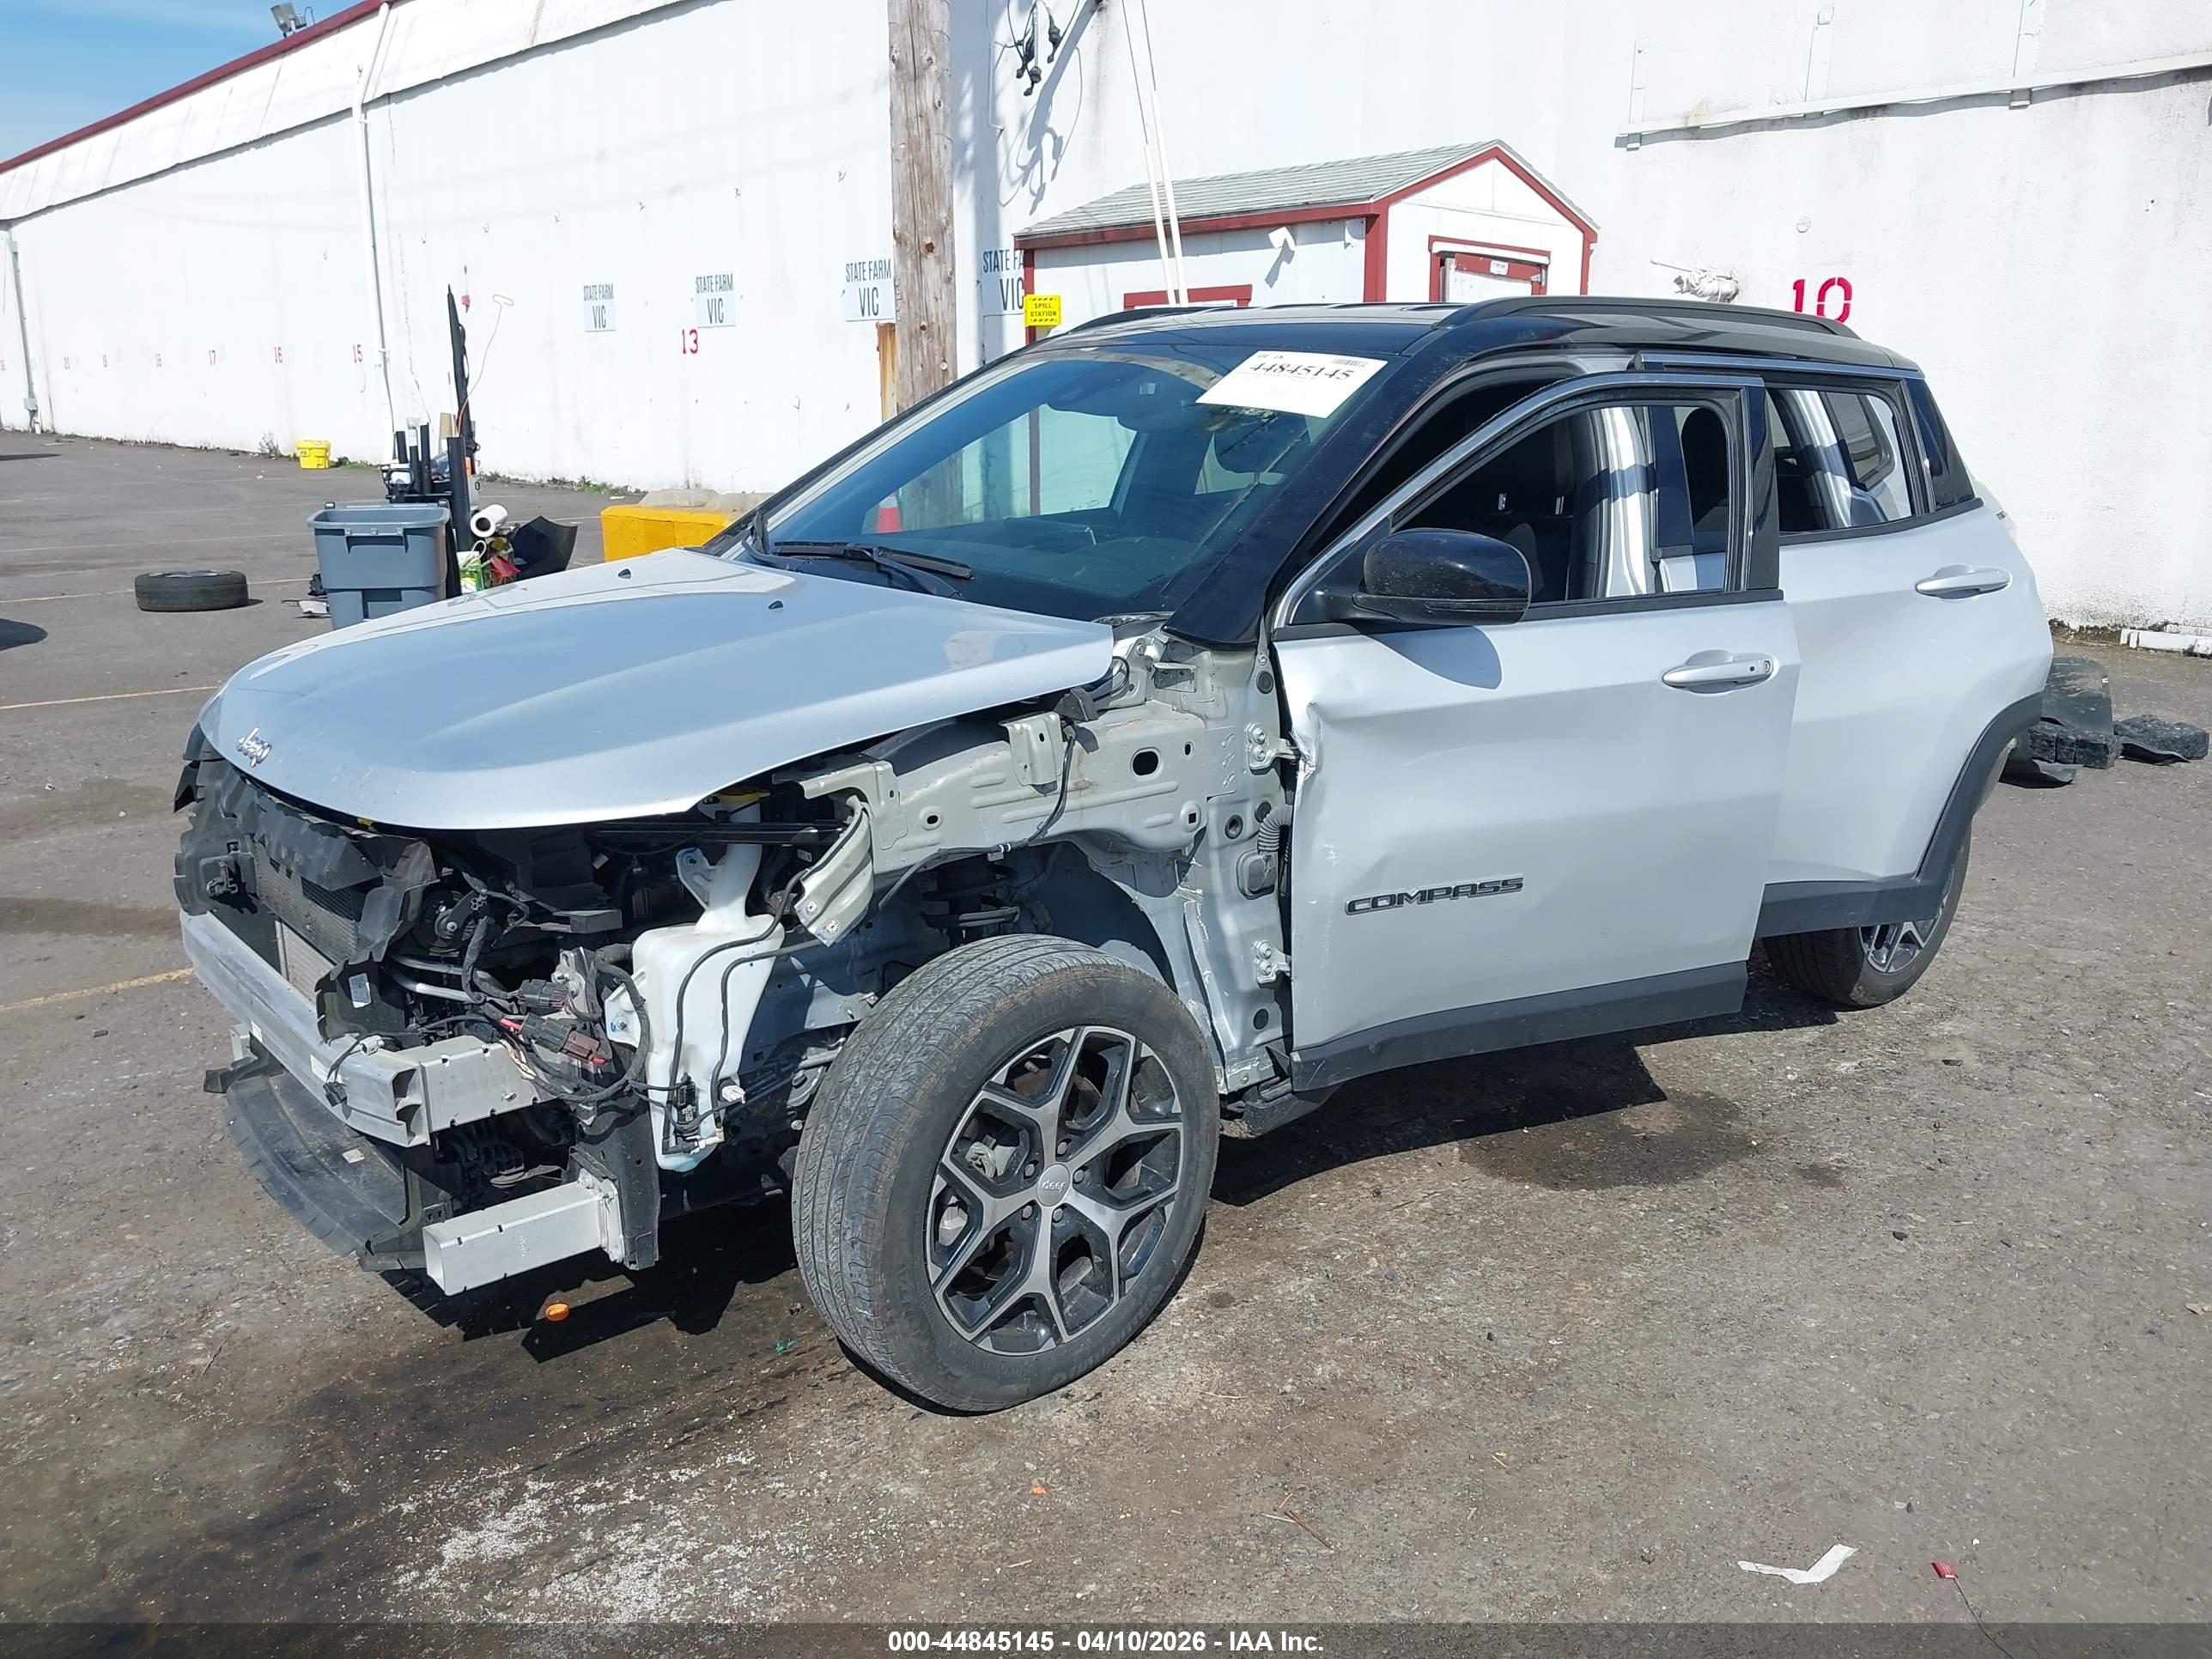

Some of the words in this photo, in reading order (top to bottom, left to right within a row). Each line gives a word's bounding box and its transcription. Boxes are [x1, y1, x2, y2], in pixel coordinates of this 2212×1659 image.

[845, 261, 867, 283] STATE
[868, 259, 891, 281] FARM
[982, 250, 1011, 273] STATE
[1013, 248, 1024, 270] FA
[583, 285, 598, 301] STATE
[599, 283, 614, 300] FARM
[695, 276, 714, 294] STATE
[715, 273, 733, 292] FARM
[999, 276, 1024, 311] VIC
[707, 297, 724, 325] VIC
[859, 287, 879, 317] VIC
[1792, 276, 1853, 324] 10
[592, 305, 606, 330] VIC
[352, 343, 363, 364] 15
[681, 328, 699, 355] 13
[208, 349, 216, 366] 17
[274, 346, 284, 364] 16
[1249, 362, 1354, 380] 44845145
[1346, 874, 1524, 915] COMPASS
